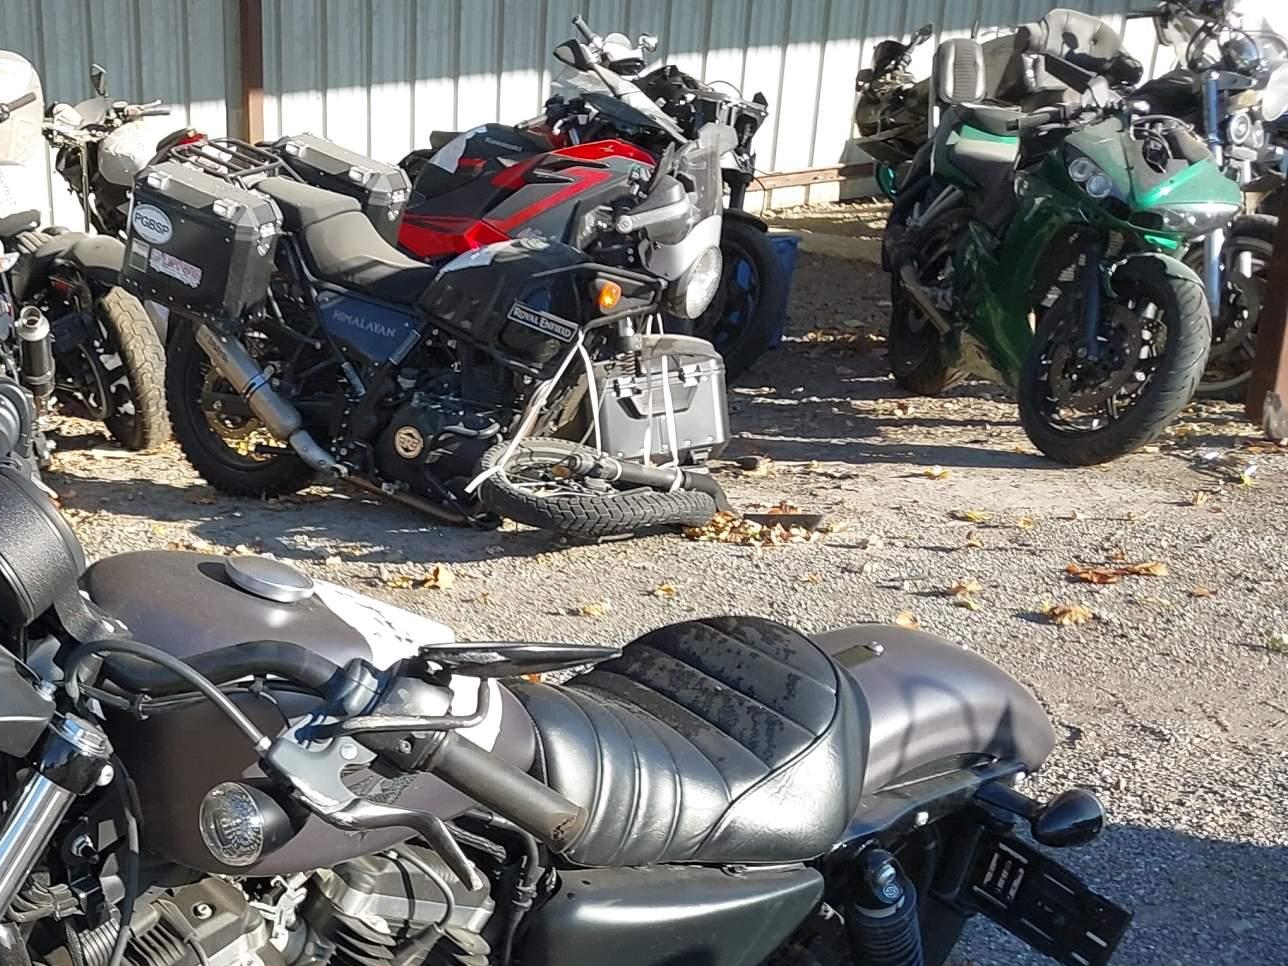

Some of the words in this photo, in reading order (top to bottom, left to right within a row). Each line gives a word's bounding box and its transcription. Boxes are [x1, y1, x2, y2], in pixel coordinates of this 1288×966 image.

[134, 211, 169, 235] PGBSP
[332, 309, 396, 338] HIMALAYAN
[513, 306, 539, 326] ROYAL
[539, 317, 572, 338] ENFIELD
